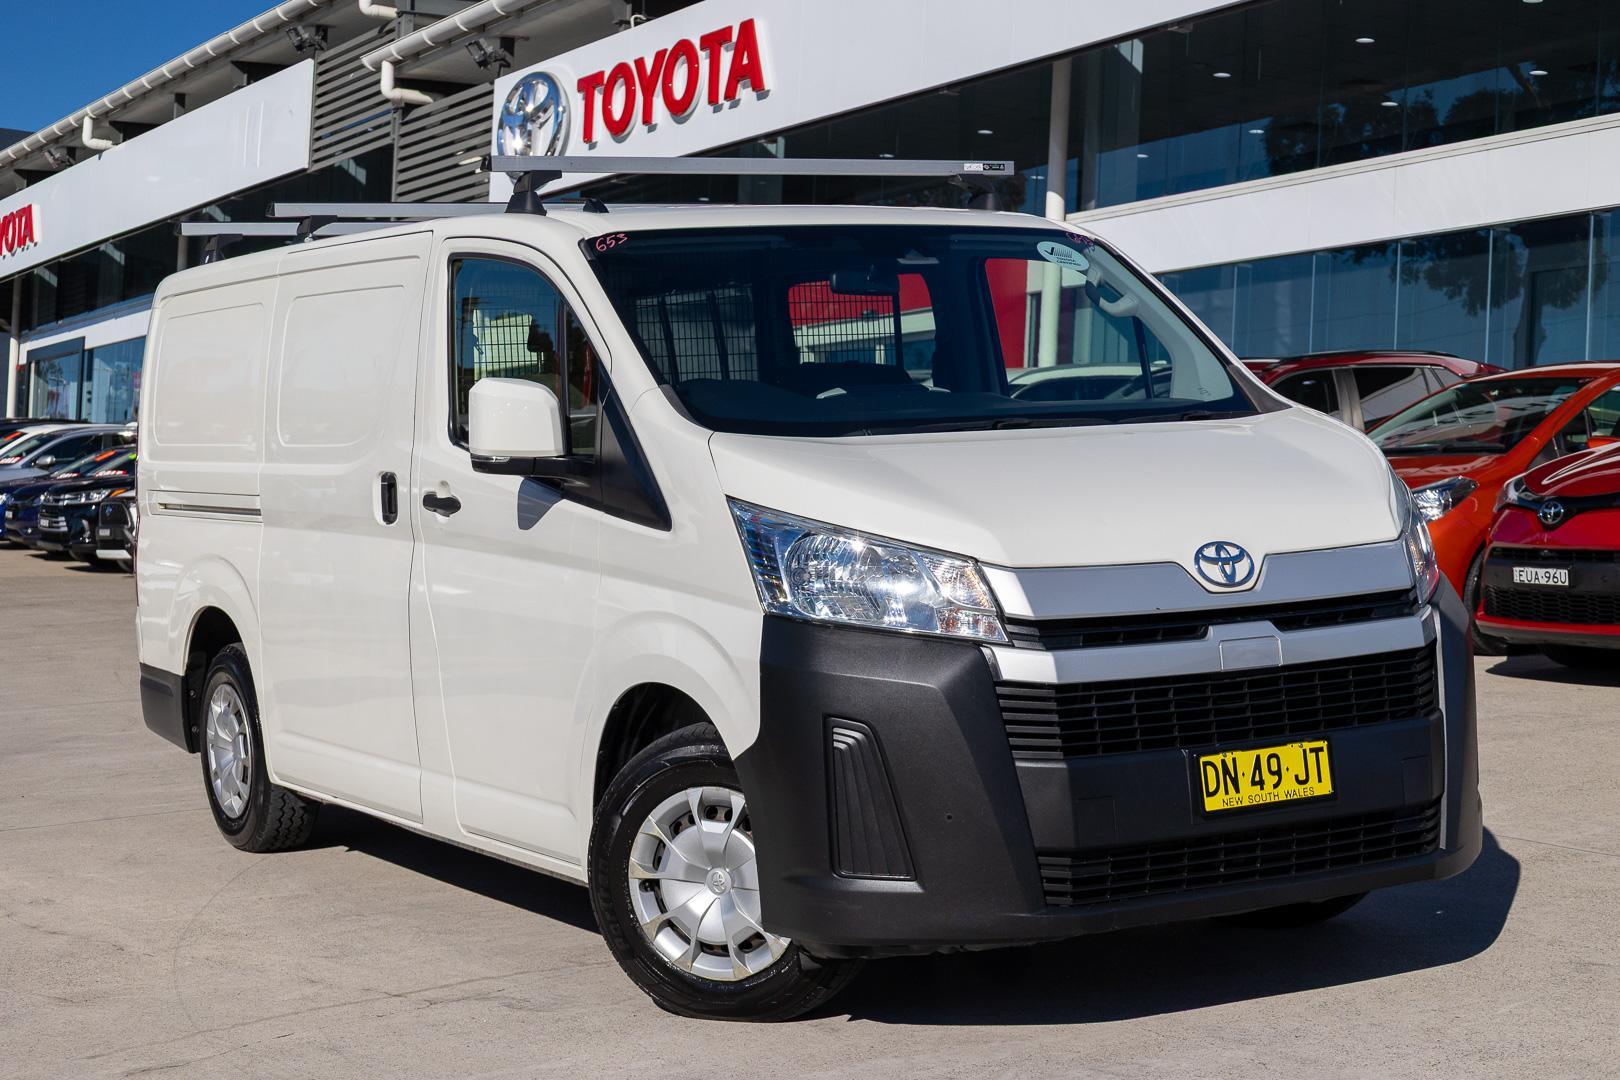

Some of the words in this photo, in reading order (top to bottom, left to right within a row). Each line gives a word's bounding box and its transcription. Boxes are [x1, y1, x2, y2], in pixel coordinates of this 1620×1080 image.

[577, 18, 766, 144] TOYOTA
[595, 233, 628, 252] 653
[1222, 796, 1243, 807] NEW
[1248, 790, 1280, 804] SOUTH
[1283, 786, 1315, 799] WALES
